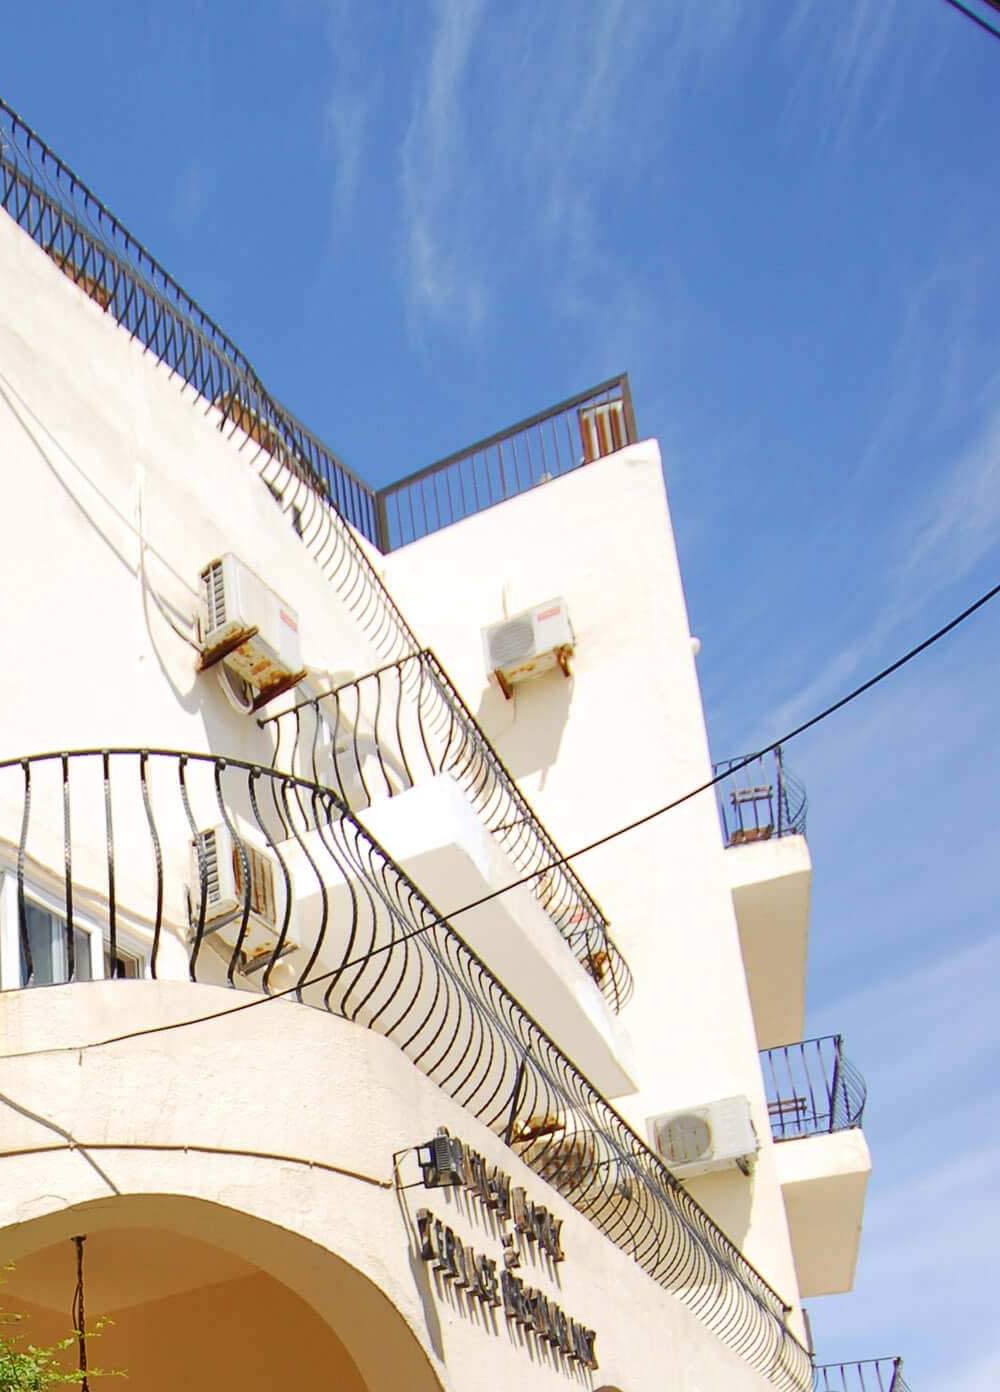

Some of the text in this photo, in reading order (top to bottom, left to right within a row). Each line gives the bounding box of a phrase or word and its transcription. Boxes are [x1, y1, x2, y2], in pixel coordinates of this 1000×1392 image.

[436, 1126, 565, 1262] RITISH HOTEL
[500, 1269, 599, 1370] RESTAURANT
